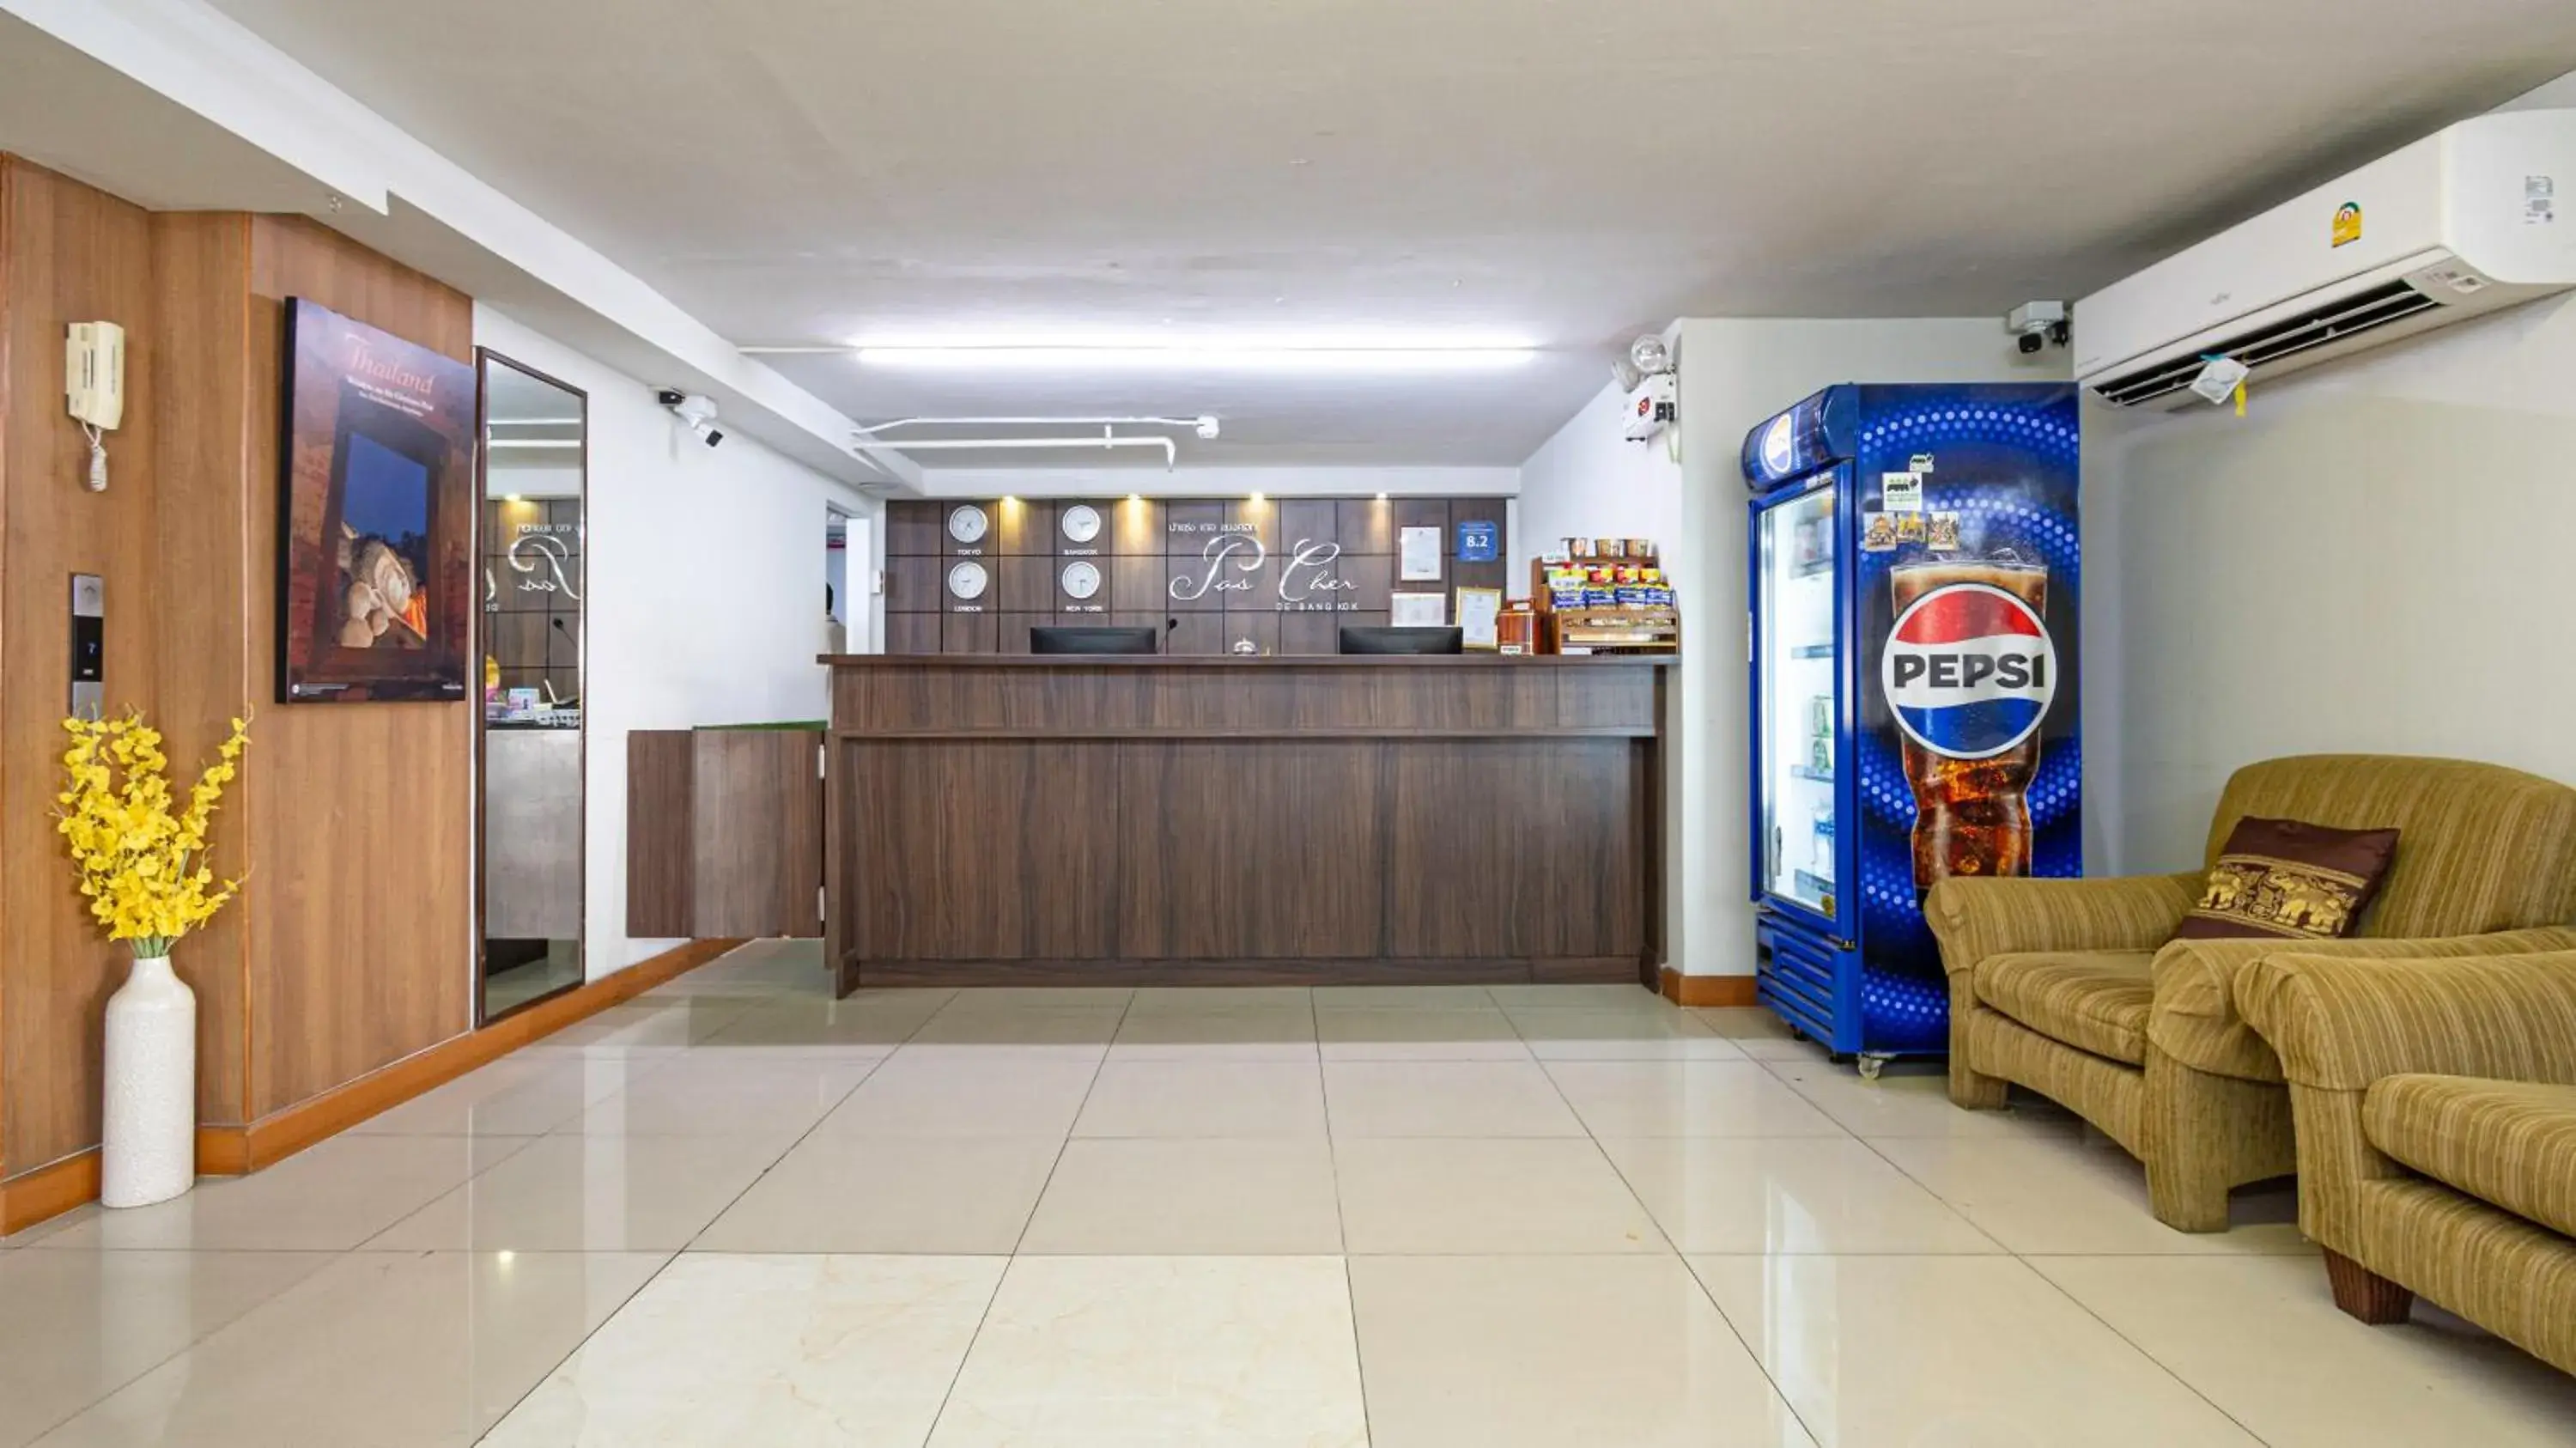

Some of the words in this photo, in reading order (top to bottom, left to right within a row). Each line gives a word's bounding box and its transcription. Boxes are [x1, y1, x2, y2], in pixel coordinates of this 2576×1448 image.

[345, 333, 436, 394] Thailand
[1466, 535, 1488, 548] 8.2
[1169, 533, 1265, 600] Pas
[1279, 538, 1359, 602] Cher
[1276, 602, 1292, 611] DE
[1893, 653, 2044, 689] PEPSI
